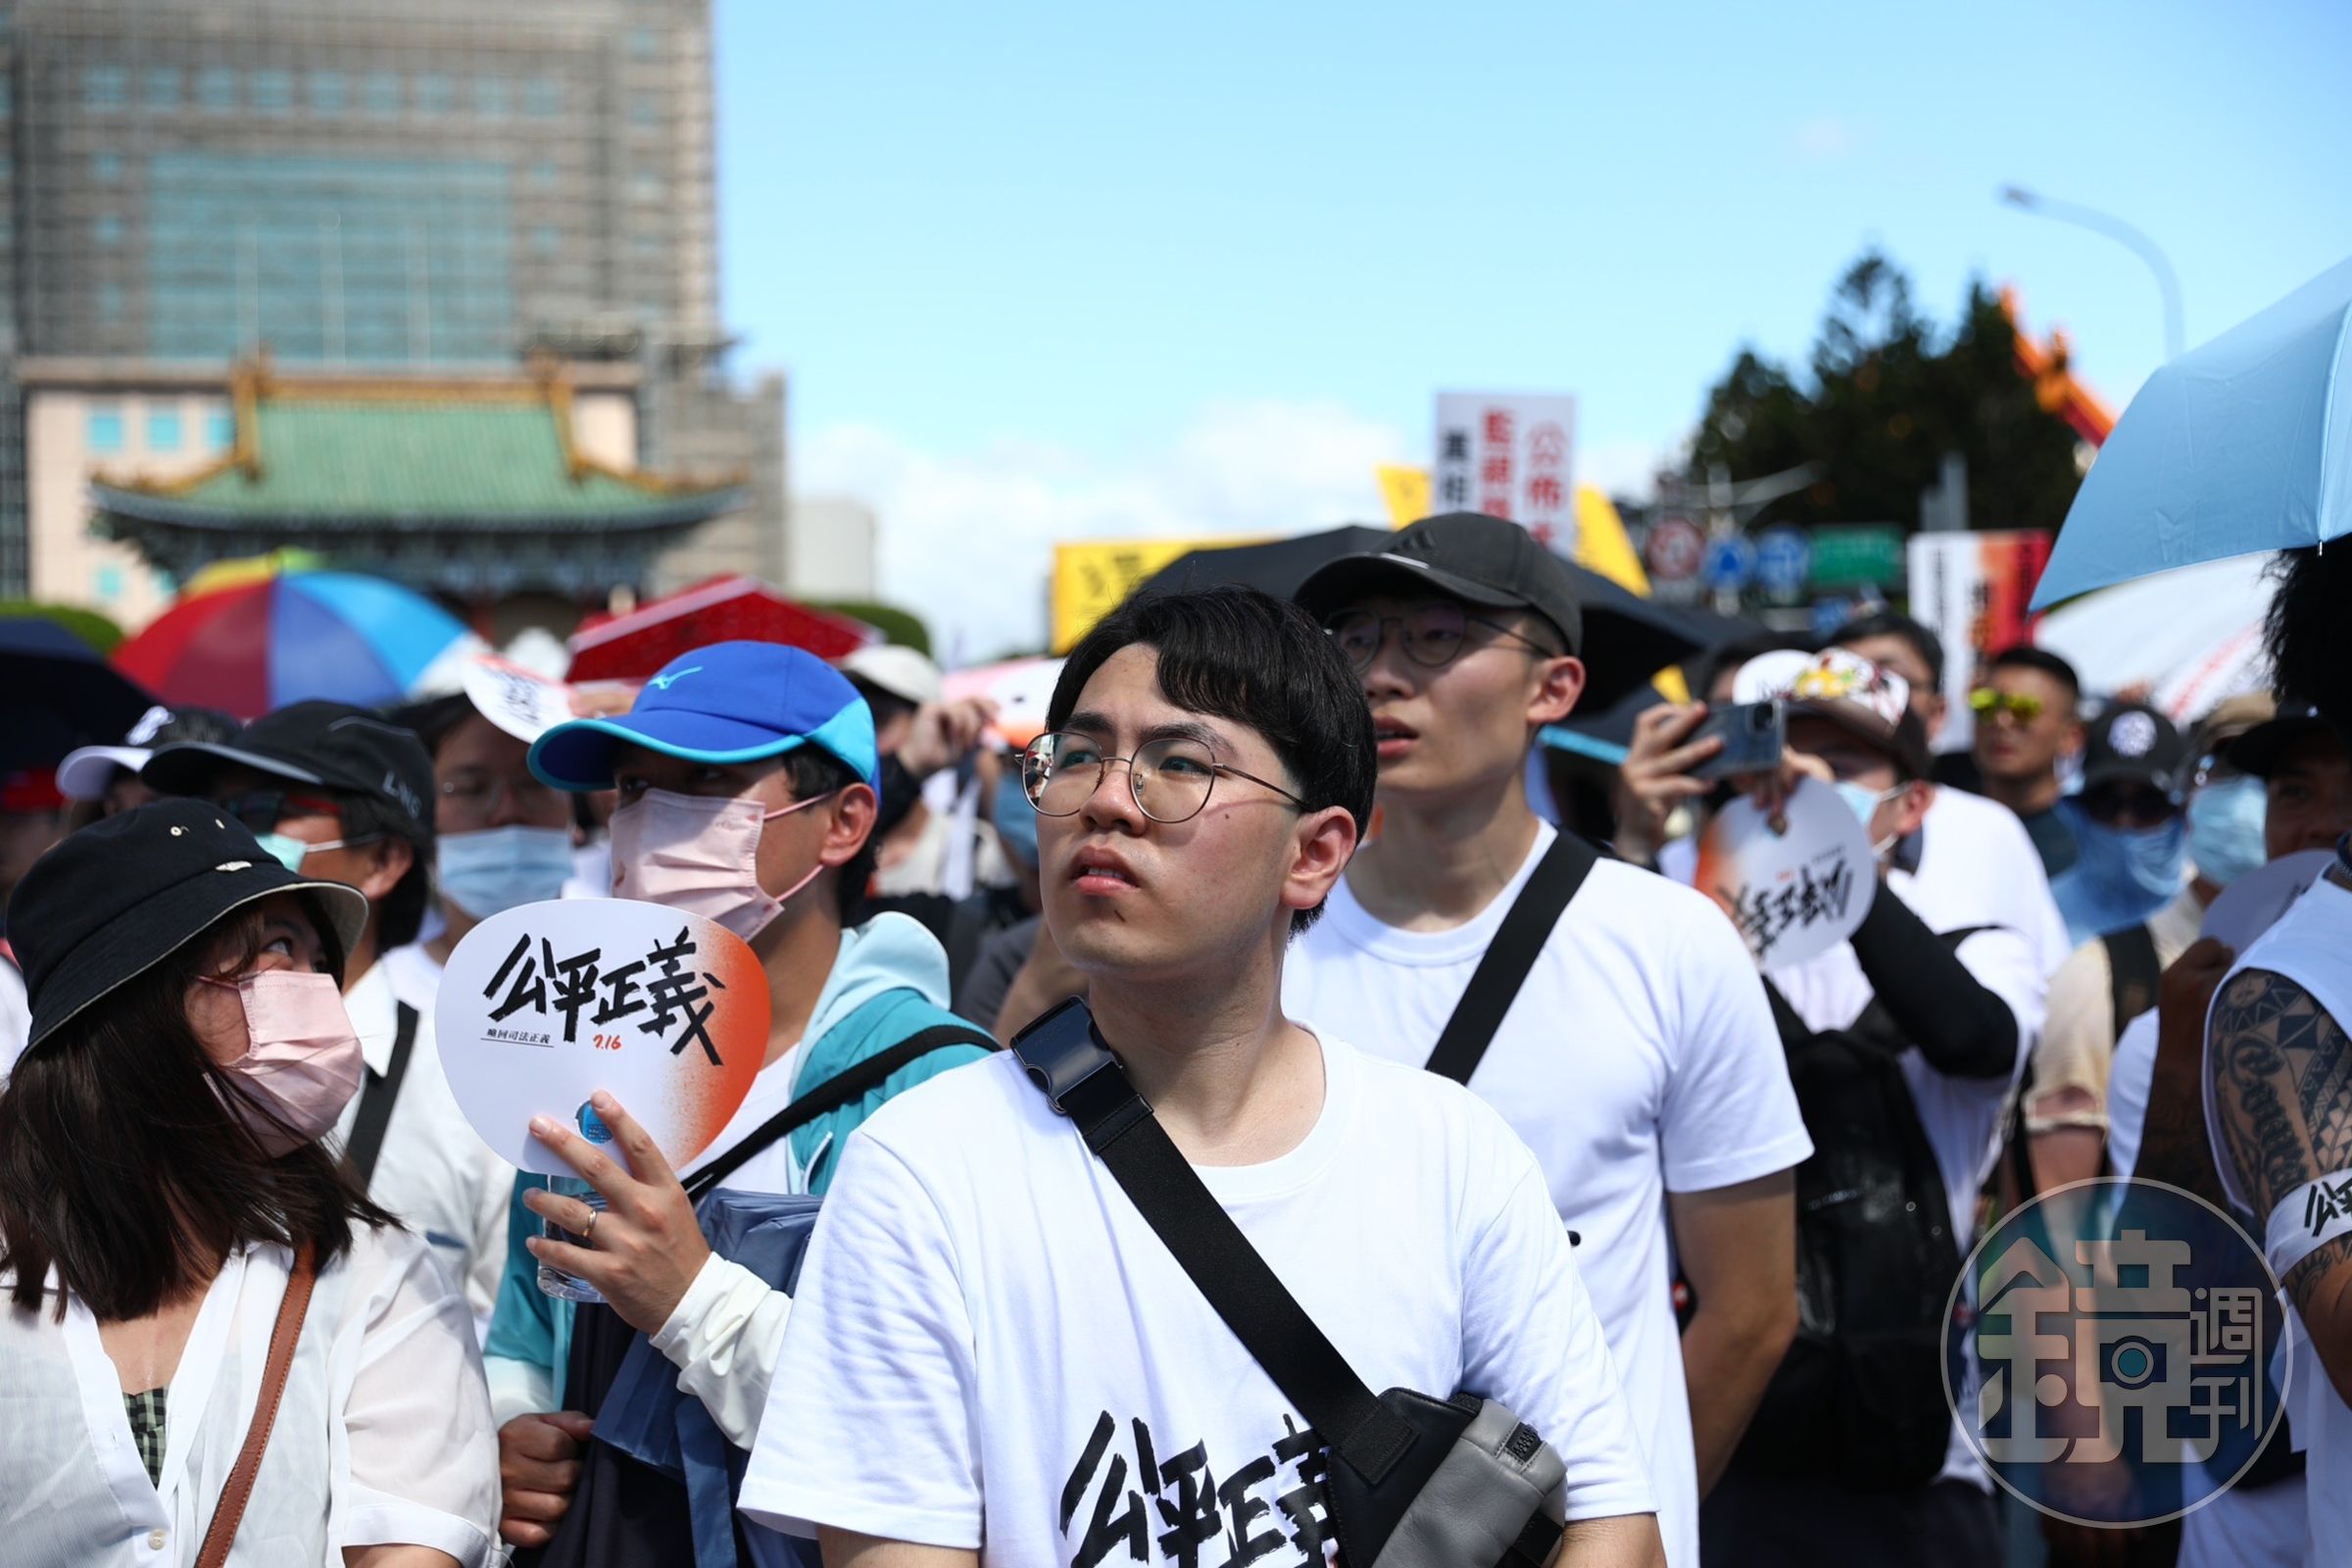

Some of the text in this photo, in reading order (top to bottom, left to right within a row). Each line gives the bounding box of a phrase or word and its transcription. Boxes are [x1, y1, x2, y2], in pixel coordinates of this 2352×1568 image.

[482, 925, 726, 1066] 公平正義
[593, 1033, 622, 1051] 7.16
